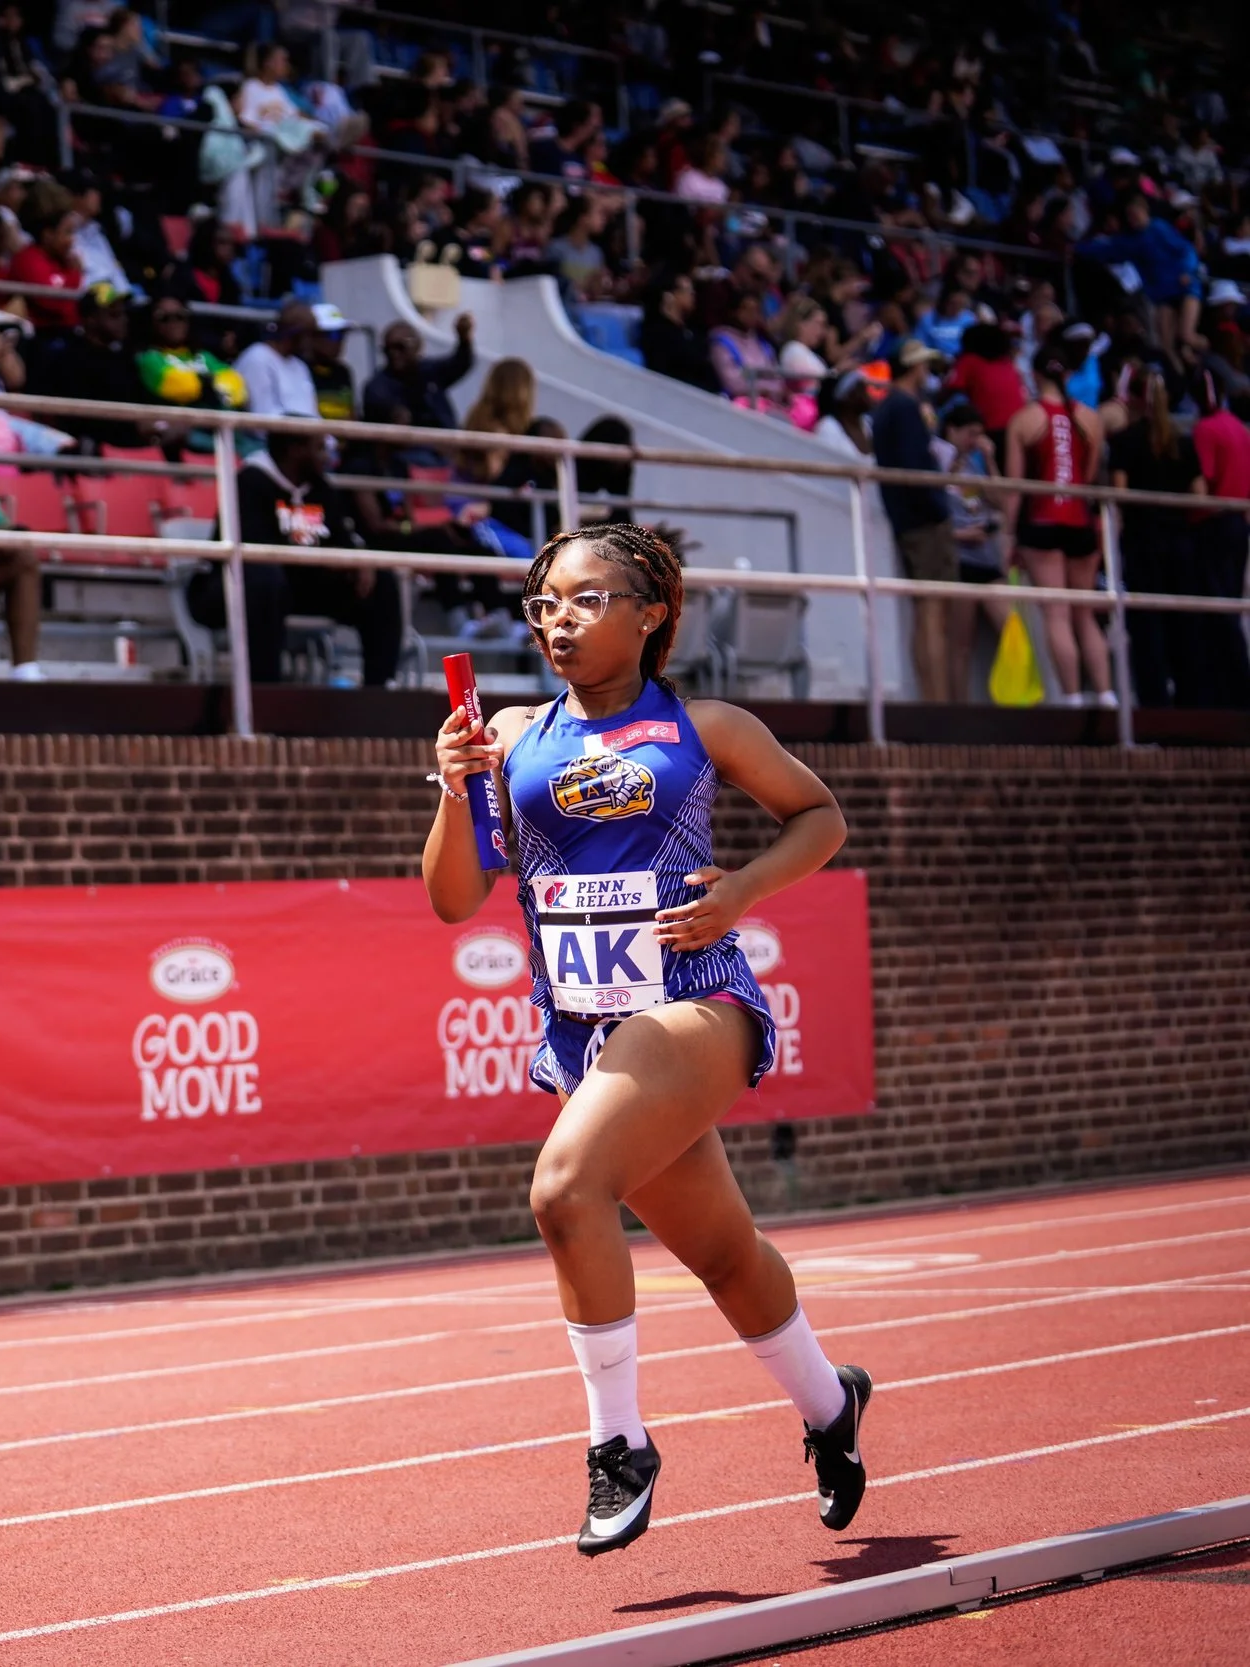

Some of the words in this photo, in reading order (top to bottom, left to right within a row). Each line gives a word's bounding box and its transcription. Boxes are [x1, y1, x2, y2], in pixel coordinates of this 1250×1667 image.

[463, 688, 476, 722] MERICA
[575, 892, 642, 908] RELAYS
[576, 880, 626, 893] PENN
[557, 928, 648, 985] AK
[164, 963, 220, 984] Grace
[595, 989, 631, 1008] 250
[132, 1010, 259, 1070] GOOD
[139, 1062, 263, 1121] MOVE
